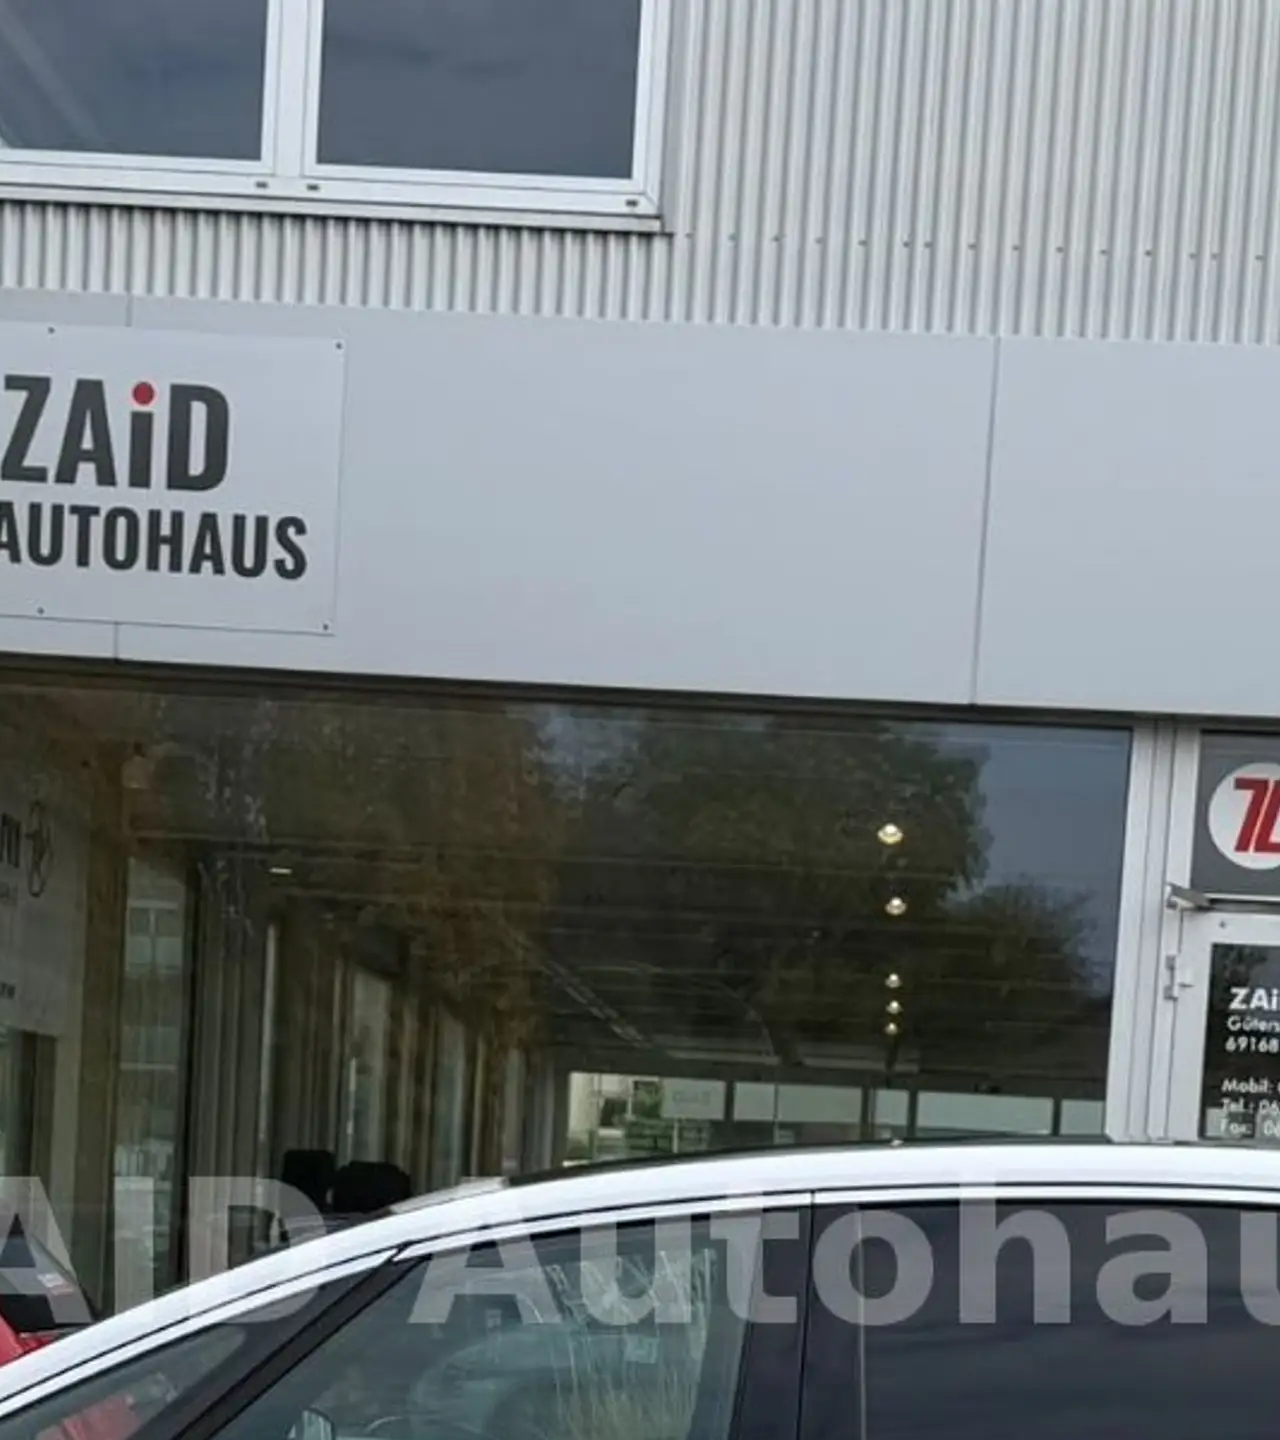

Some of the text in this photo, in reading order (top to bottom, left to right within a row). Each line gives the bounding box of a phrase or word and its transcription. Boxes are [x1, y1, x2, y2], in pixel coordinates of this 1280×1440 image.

[0, 373, 231, 493] ZAiD
[1224, 1036, 1280, 1054] 69168
[1221, 1077, 1274, 1094] Mobil:
